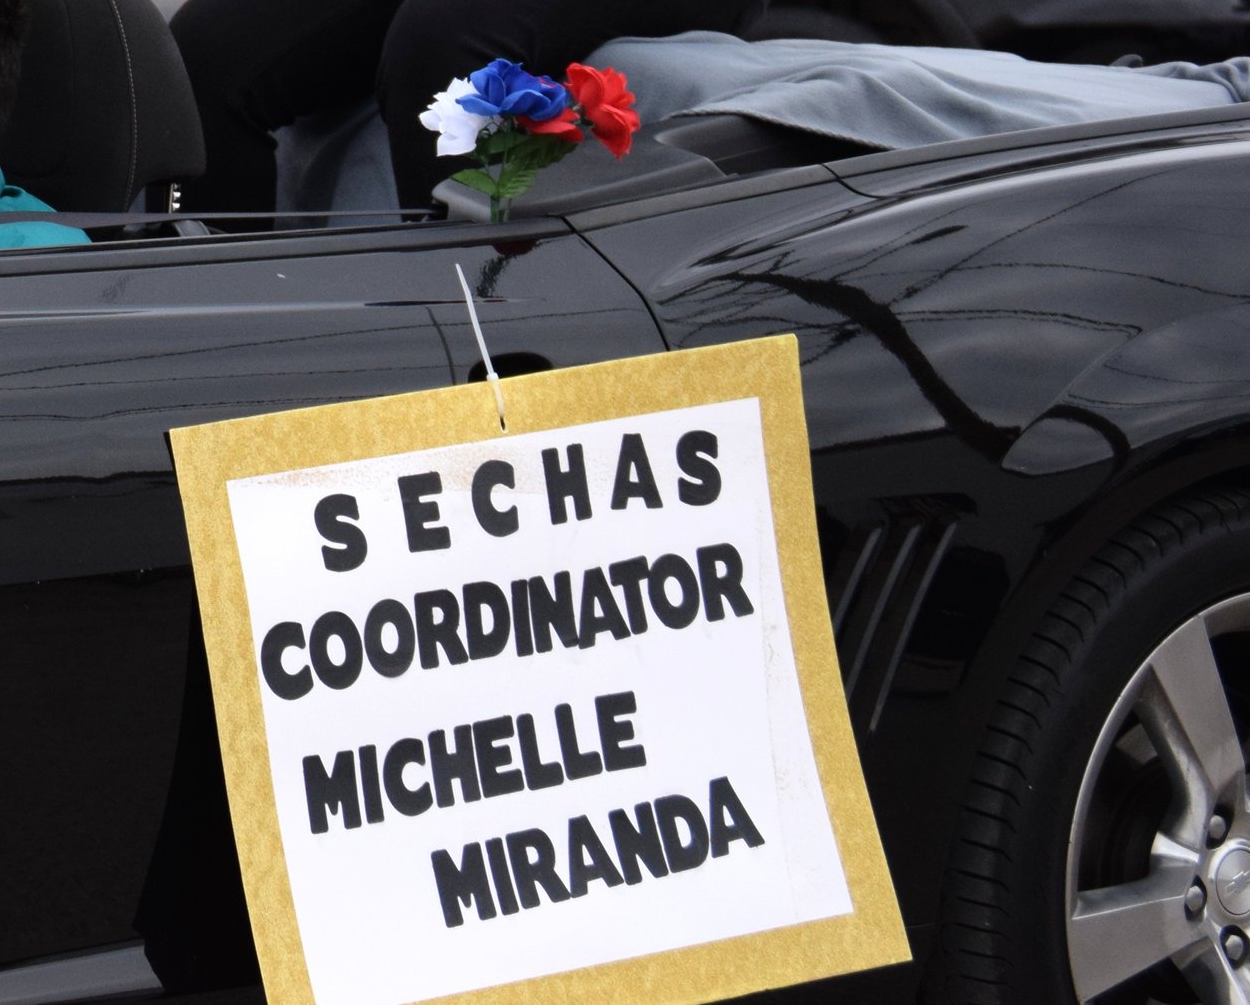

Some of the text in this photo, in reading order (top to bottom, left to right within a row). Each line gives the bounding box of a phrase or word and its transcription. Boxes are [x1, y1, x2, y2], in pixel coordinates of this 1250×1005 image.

[260, 543, 754, 701] COORDINATOR
[302, 691, 647, 834] MICHELLE
[431, 776, 765, 928] MIRANDA
